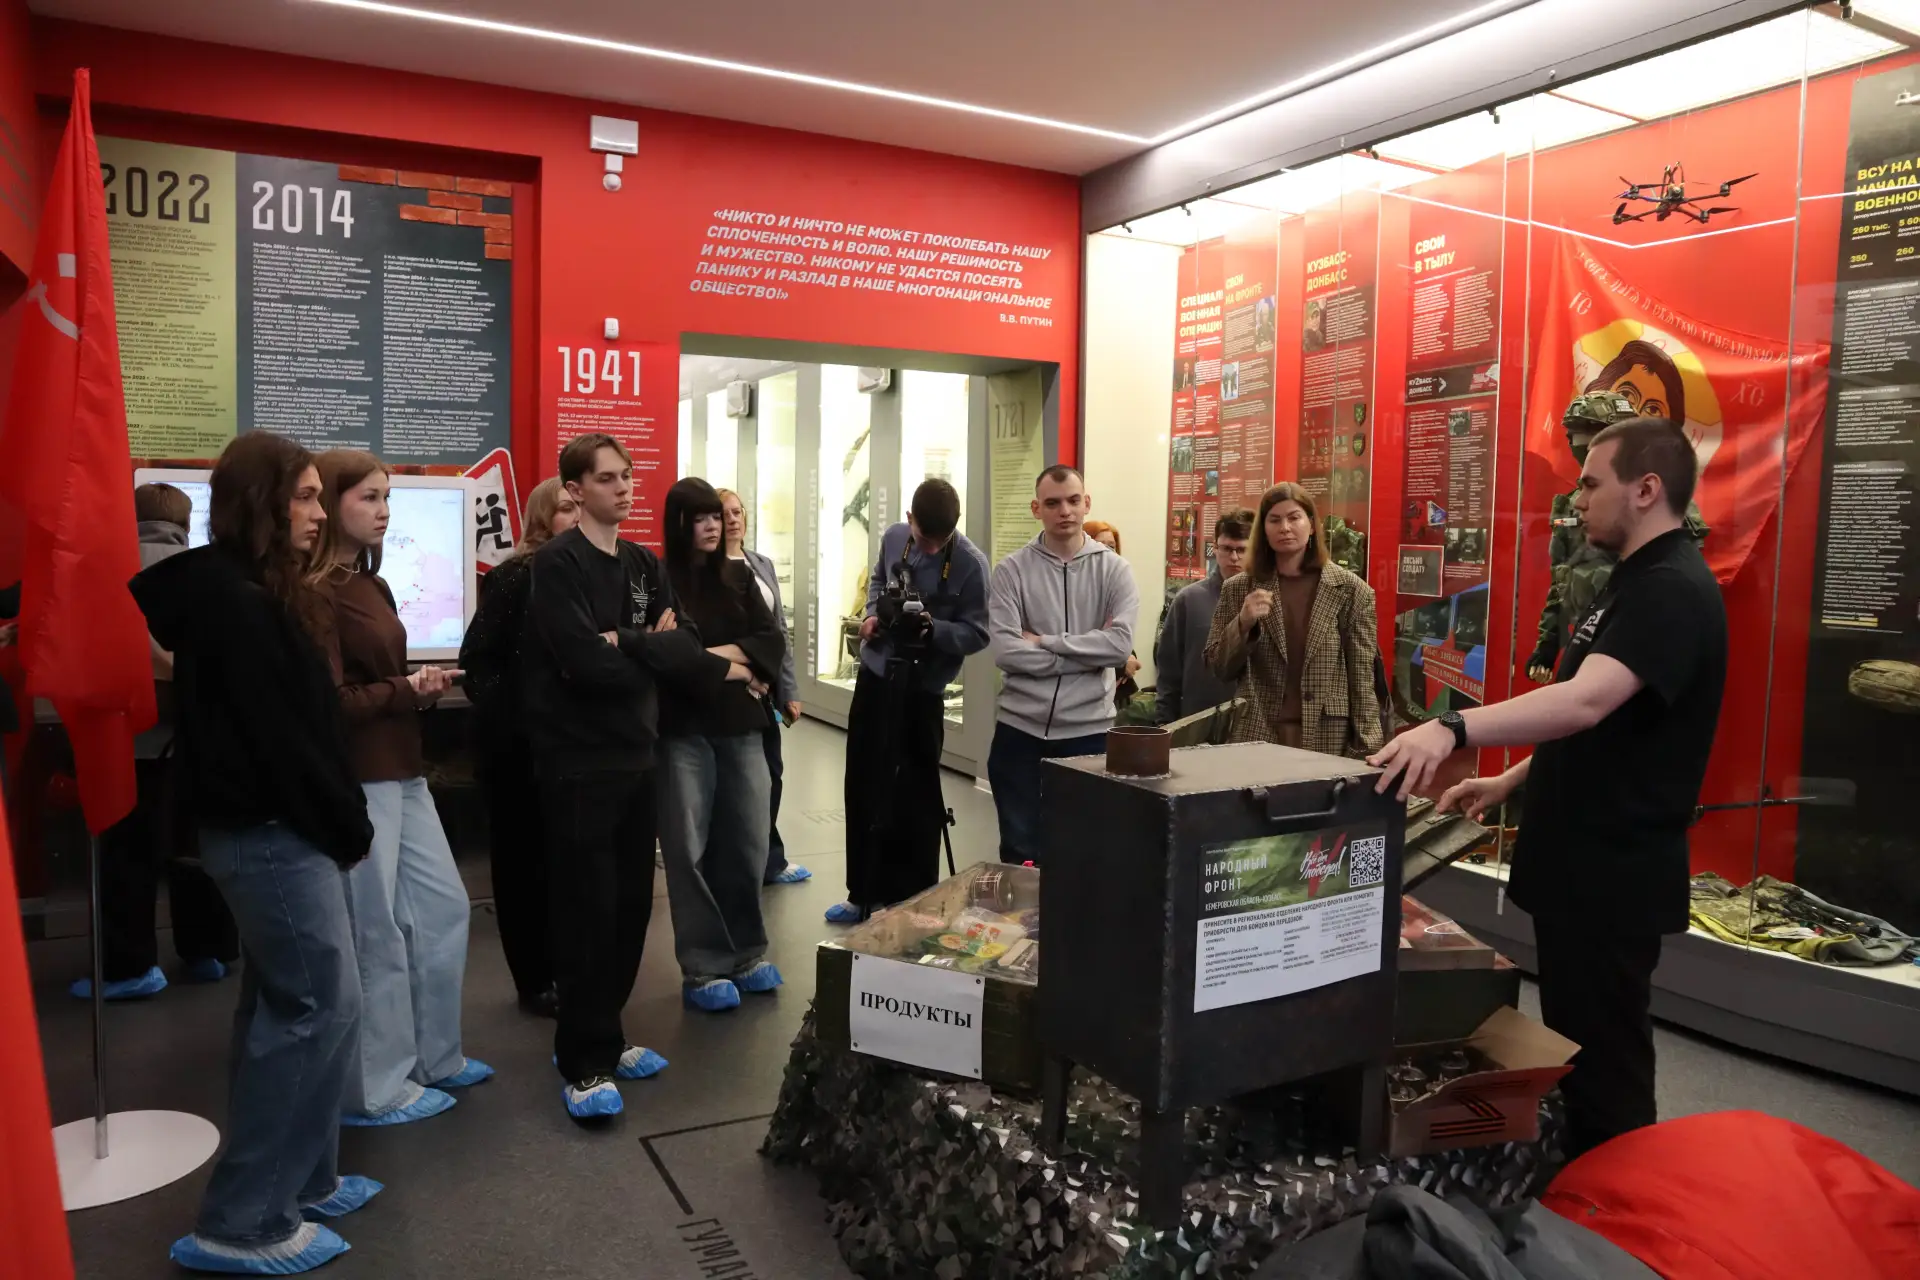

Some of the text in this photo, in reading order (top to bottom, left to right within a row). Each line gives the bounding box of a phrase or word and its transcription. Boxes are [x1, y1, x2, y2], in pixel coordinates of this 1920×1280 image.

[1857, 159, 1912, 181] ВСУ НА
[99, 163, 211, 224] 2022
[1856, 175, 1917, 196] НАЧАЛА
[252, 180, 354, 238] 2014
[1855, 189, 1920, 211] ВОЕННО
[1852, 225, 1870, 235] 260
[1871, 224, 1891, 232] тыс.
[1899, 216, 1920, 227] 5 60
[713, 209, 1051, 260] «НИКТО И НИЧТО НЕ МОЖЕТ ПОКОЛЕБАТЬ НАШУ
[1415, 234, 1446, 254] СВОИ
[707, 225, 1024, 273] СПЛОЧЕННОСТЬ И ВОЛЮ. НАШУ РЕШИМОСТЬ
[1850, 253, 1868, 263] 350
[1896, 247, 1914, 256] 260
[700, 243, 1023, 289] И МУЖЕСТВО. НИКОМУ НЕ УДАСТСЯ ПОСЕЯТЬ
[1307, 251, 1347, 274] КУЗБАСС
[1414, 251, 1455, 273] В ТЫЛУ
[690, 279, 789, 300] ОБЩЕСТВО!»
[696, 261, 1053, 310] ПАНИКУ И РАЗЛАД В НАШЕ МНОГОНАЦИОНАЛЬНОЕ
[1306, 268, 1348, 292] ДОНБАСС
[1235, 282, 1263, 302] ФРОНТЕ
[1000, 313, 1053, 327] В.В. ПУТИН
[557, 346, 641, 396] 1941
[995, 403, 1025, 438] 1721
[807, 468, 817, 678] БИТВА ЗА БЕРЛИН
[1402, 563, 1425, 574] СОЛДАТУ
[1205, 854, 1267, 877] НАРОДНЫЙ
[1204, 877, 1242, 894] ФРОНТ
[1205, 898, 1239, 911] КЕМЕРОВСКАЯ
[1203, 920, 1232, 928] ПРИНЕСИТЕ
[1237, 912, 1275, 924] РЕГИОНАЛЬНОЕ
[1203, 927, 1235, 937] ПРИОБРЕСТИ
[1248, 922, 1268, 931] БОЙЦОВ
[860, 991, 972, 1029] ПРОДУКТЫ
